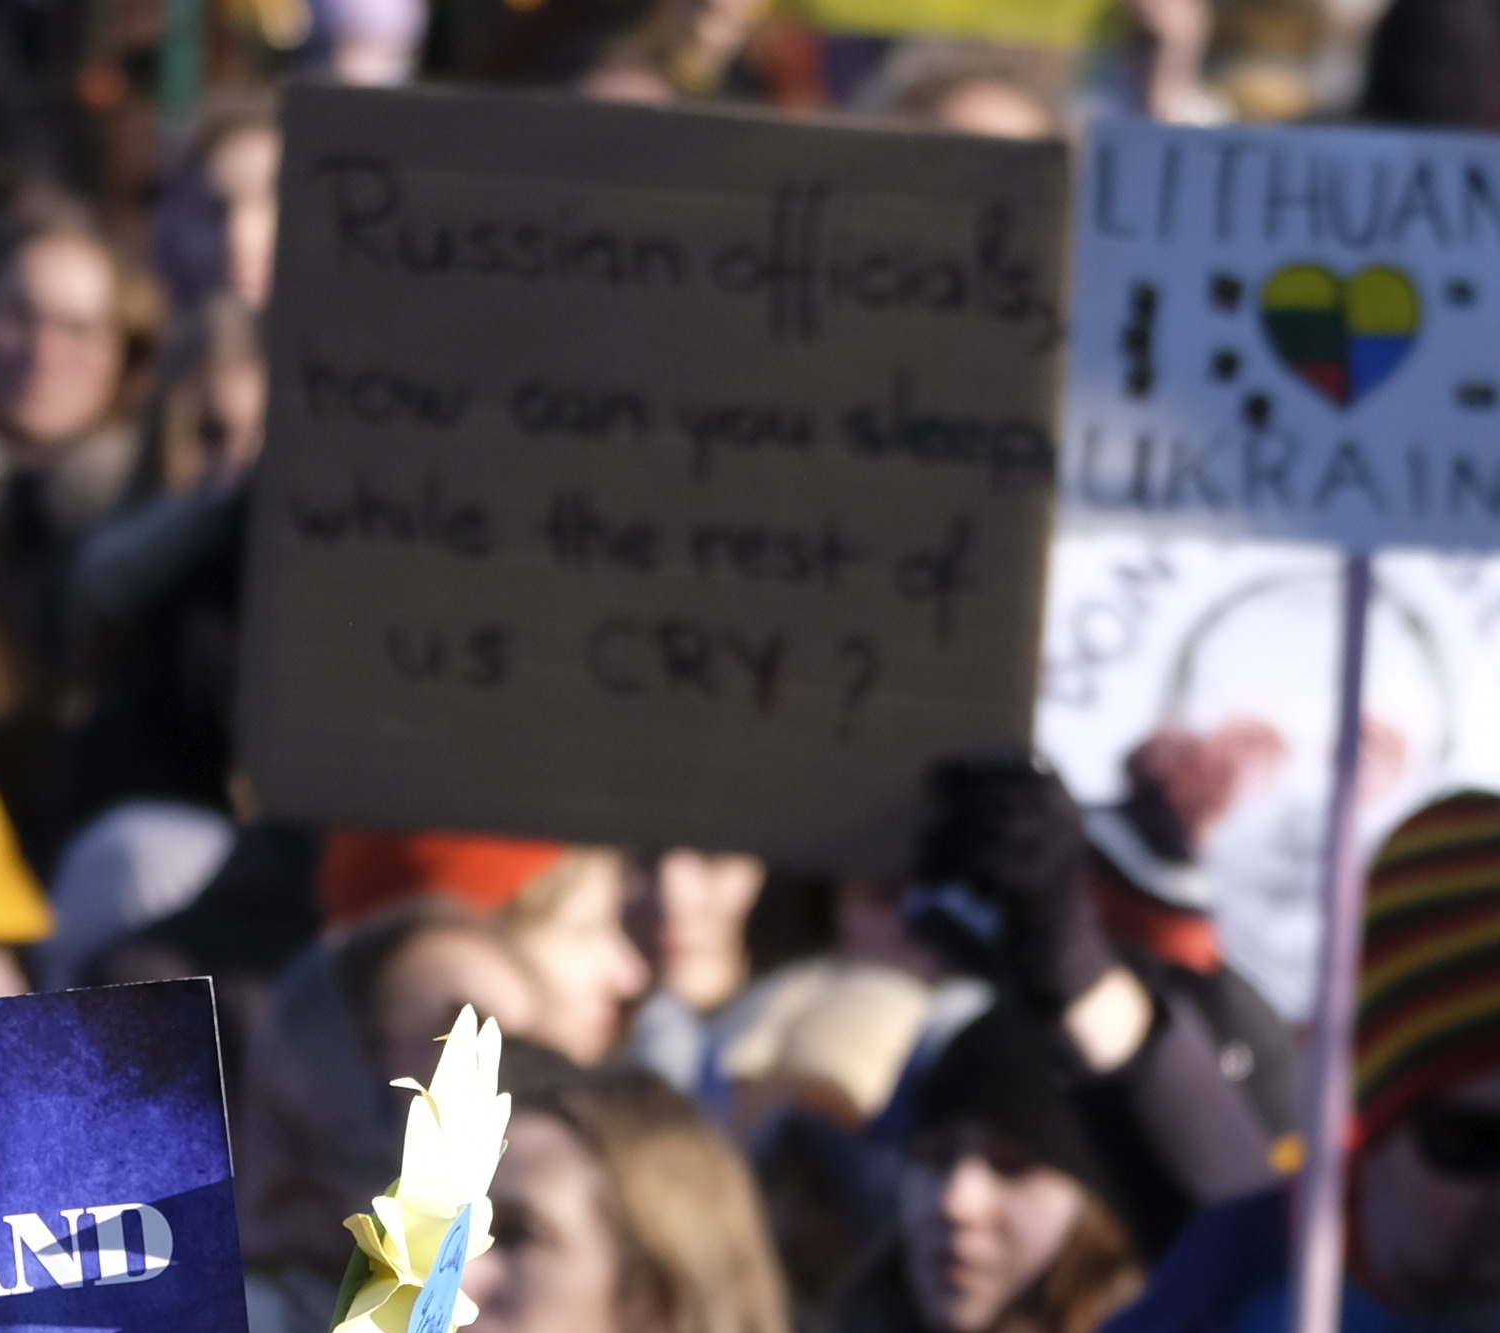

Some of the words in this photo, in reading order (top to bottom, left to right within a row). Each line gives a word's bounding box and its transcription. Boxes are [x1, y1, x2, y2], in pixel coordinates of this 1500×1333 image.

[314, 152, 689, 290] Russian
[509, 375, 650, 440] can
[675, 392, 817, 482] you
[841, 366, 1056, 495] sleep
[288, 472, 492, 560] while
[537, 488, 659, 576] the
[690, 514, 858, 586] rest
[900, 511, 979, 650] of
[383, 621, 511, 688] us
[585, 611, 790, 720] CRY
